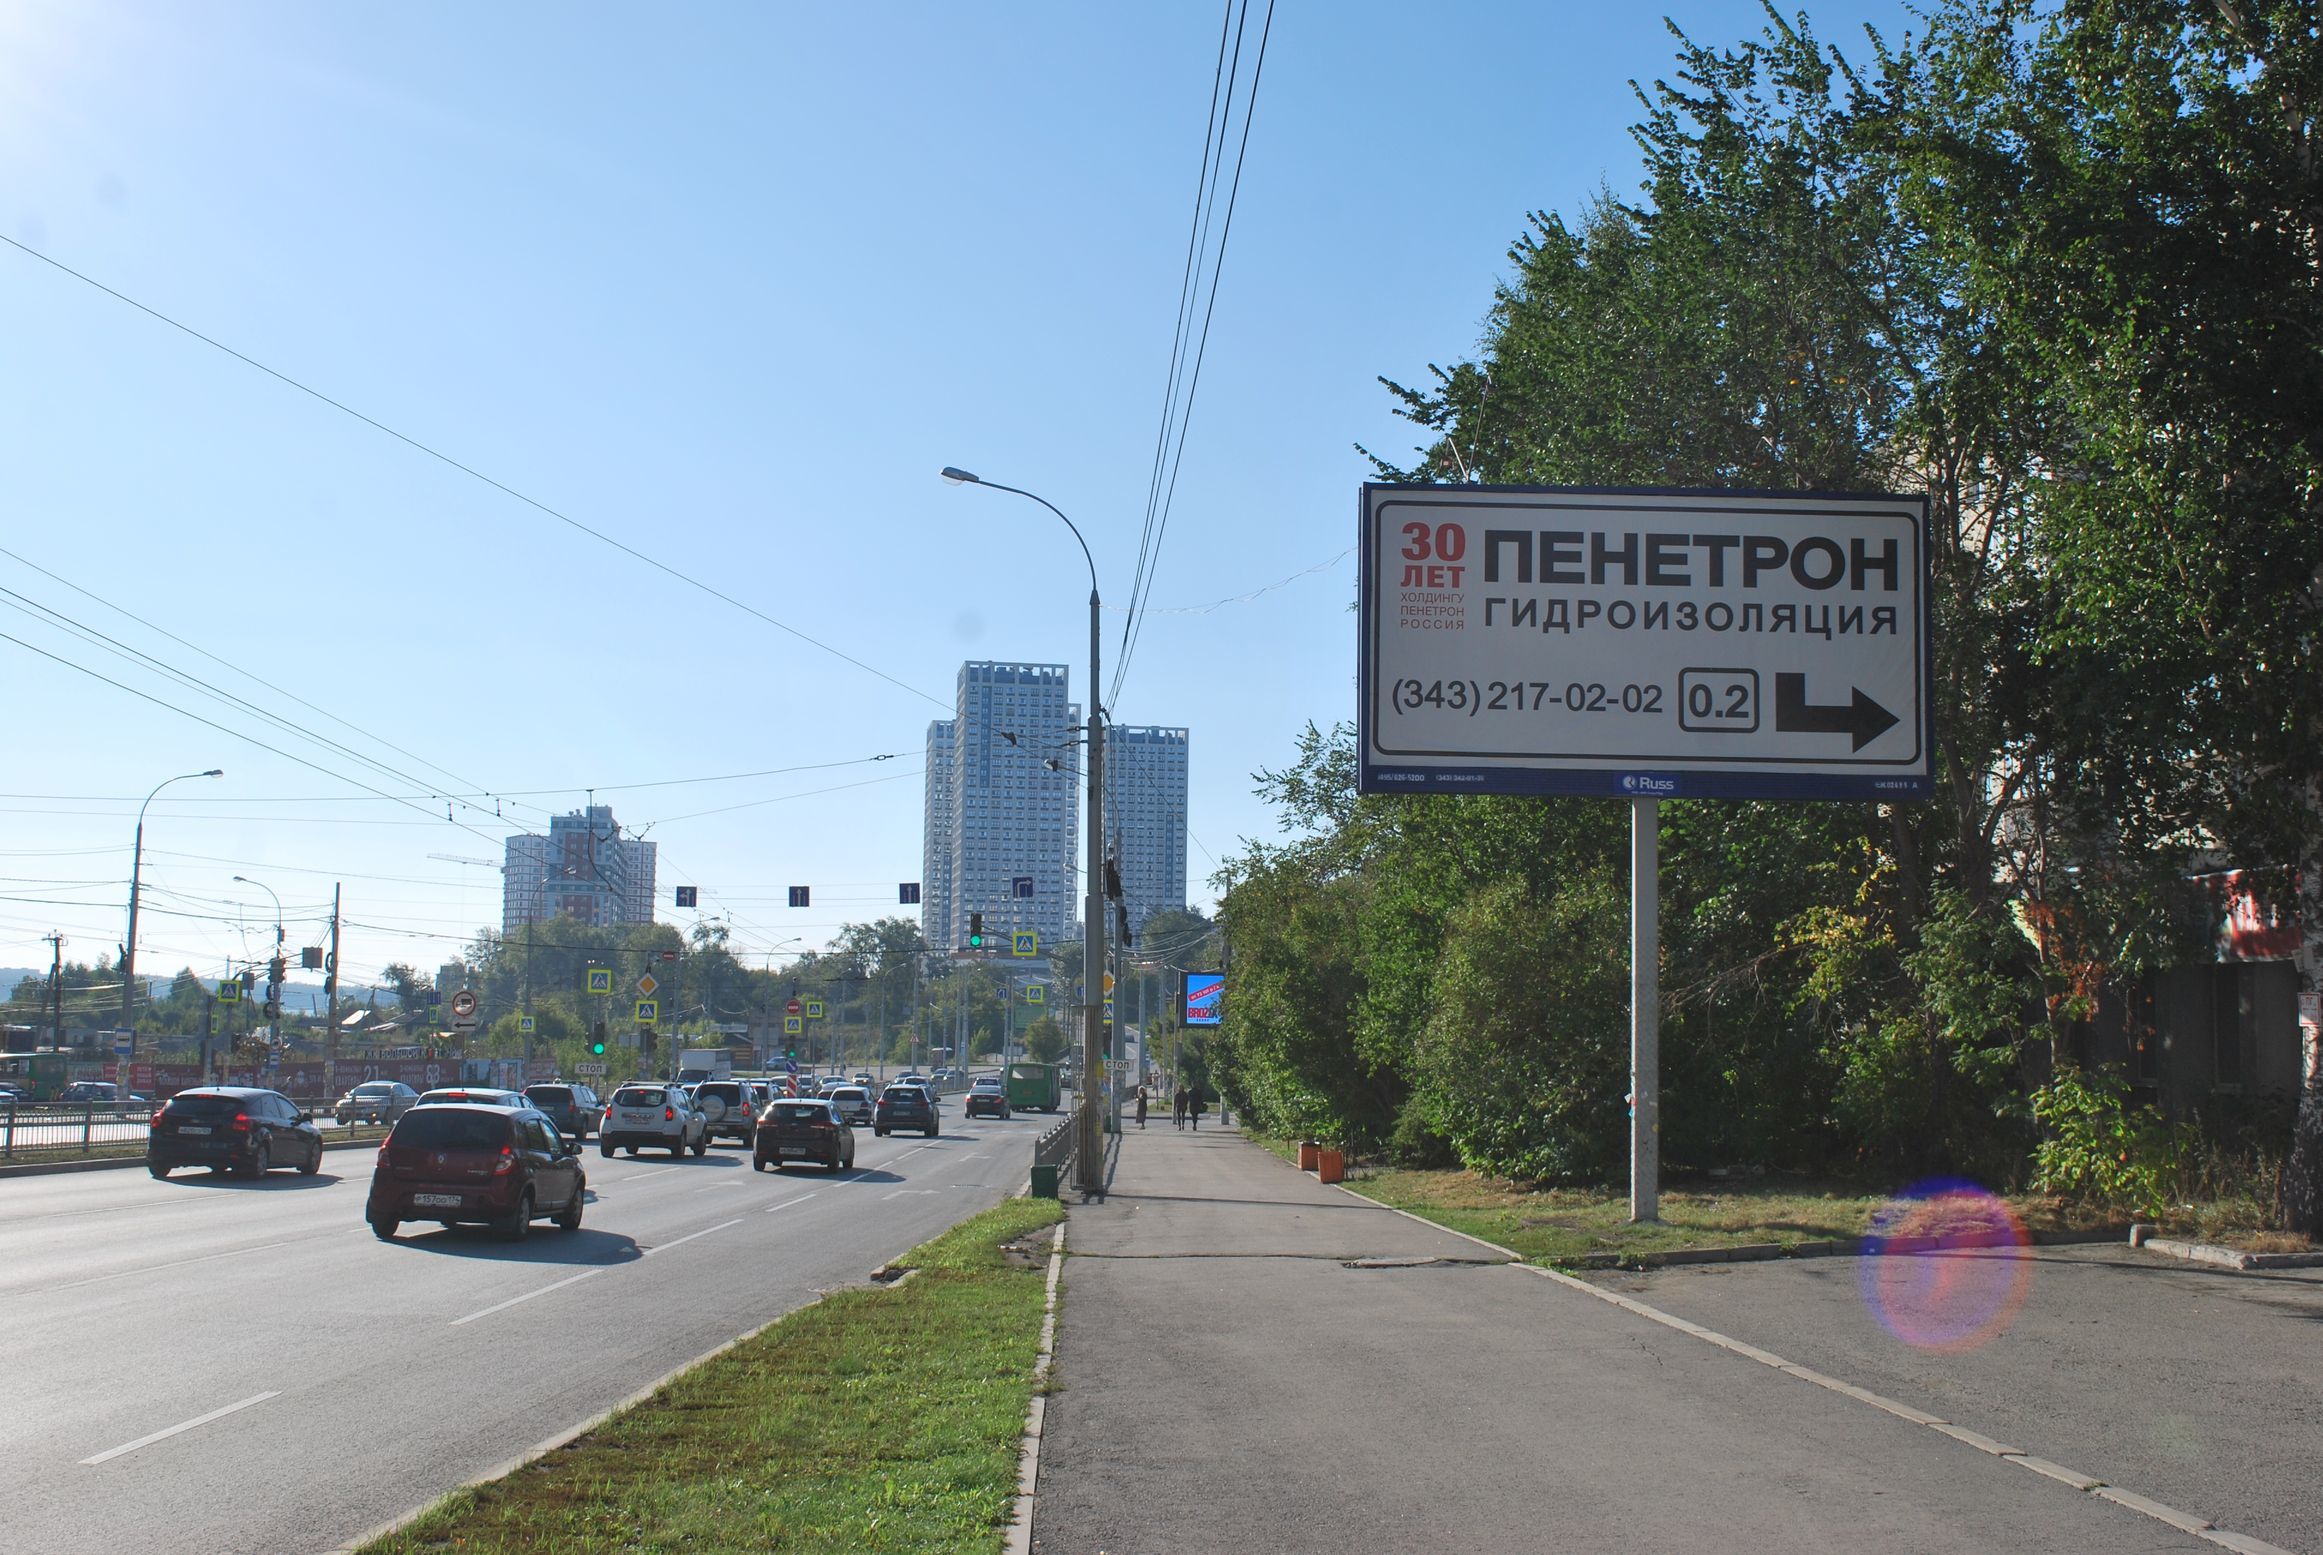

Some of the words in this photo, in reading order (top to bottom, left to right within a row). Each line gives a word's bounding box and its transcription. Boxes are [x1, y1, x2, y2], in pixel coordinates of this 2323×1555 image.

[1401, 522, 1466, 562] 30
[1485, 529, 1898, 591] ПЕНЕТРОН
[1400, 565, 1466, 588] ЛЕТ
[1401, 592, 1465, 605] ХОЛДИНГУ
[1401, 606, 1464, 617] ПЕНЕТРОН
[1485, 597, 1897, 640] ГИДРОИЗОЛЯЦИЯ
[1401, 619, 1464, 630] РОССИЯ
[1392, 679, 1481, 716] (343)
[1488, 682, 1663, 714] 217-02-02
[1688, 684, 1750, 719] 0.2
[1639, 776, 1674, 790] Russ
[578, 1063, 602, 1073] СТОП
[1105, 1060, 1130, 1069] СТОП
